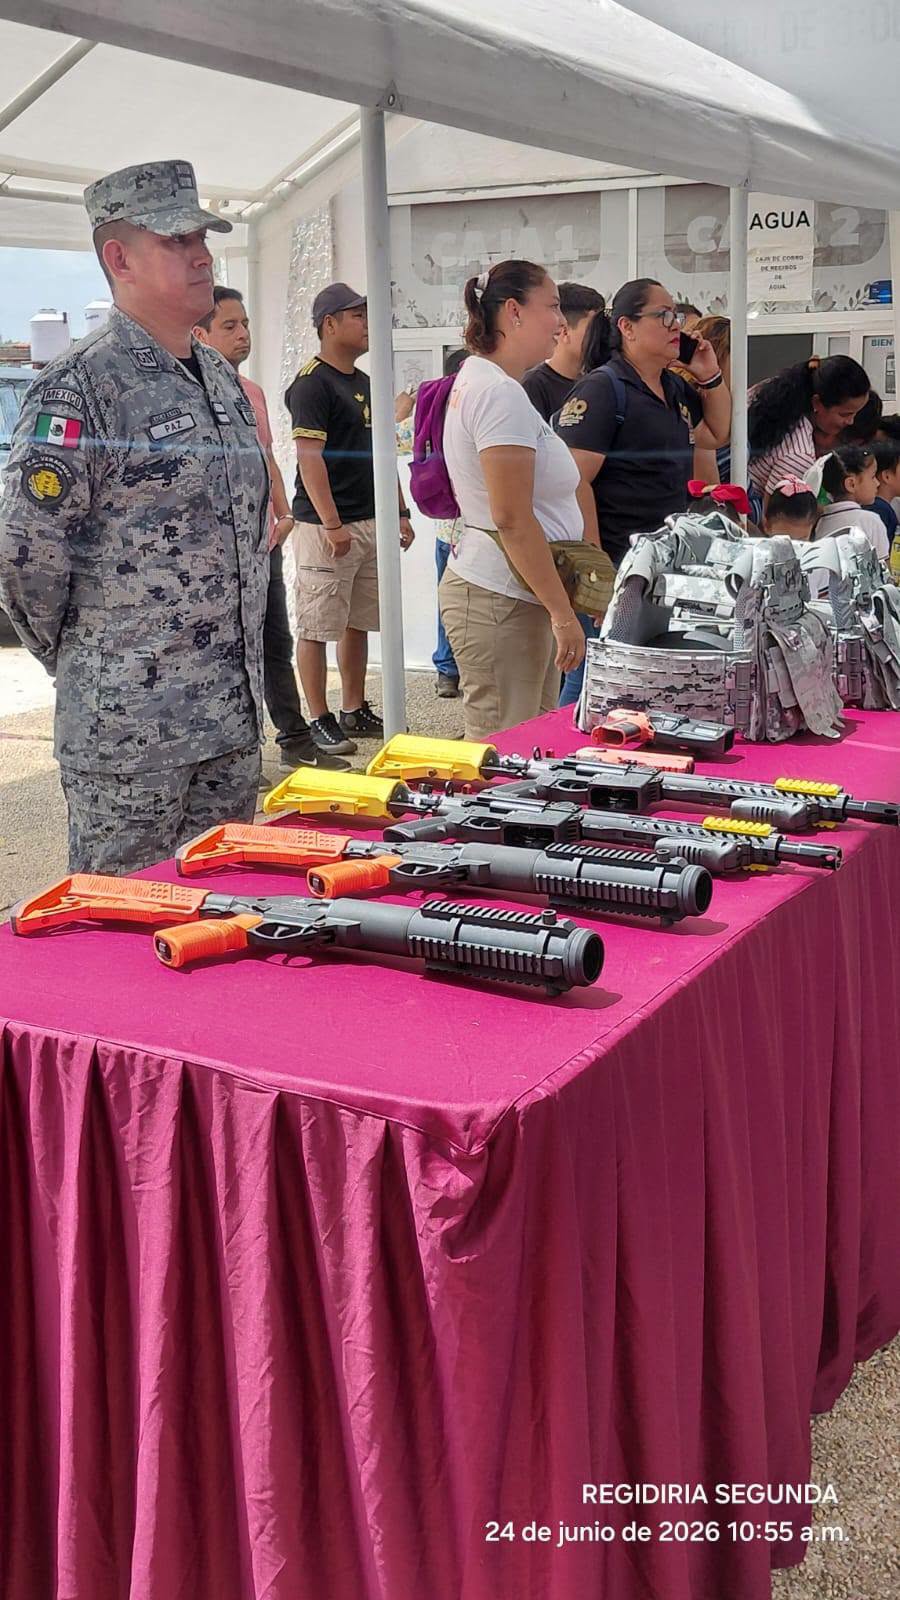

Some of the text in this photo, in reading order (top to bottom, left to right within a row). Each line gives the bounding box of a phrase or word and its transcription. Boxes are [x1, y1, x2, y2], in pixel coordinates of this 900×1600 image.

[749, 210, 811, 231] AGUA
[829, 206, 861, 246] 2
[137, 350, 155, 364] GN
[45, 389, 81, 408] MEXICO
[164, 420, 182, 433] PAZ
